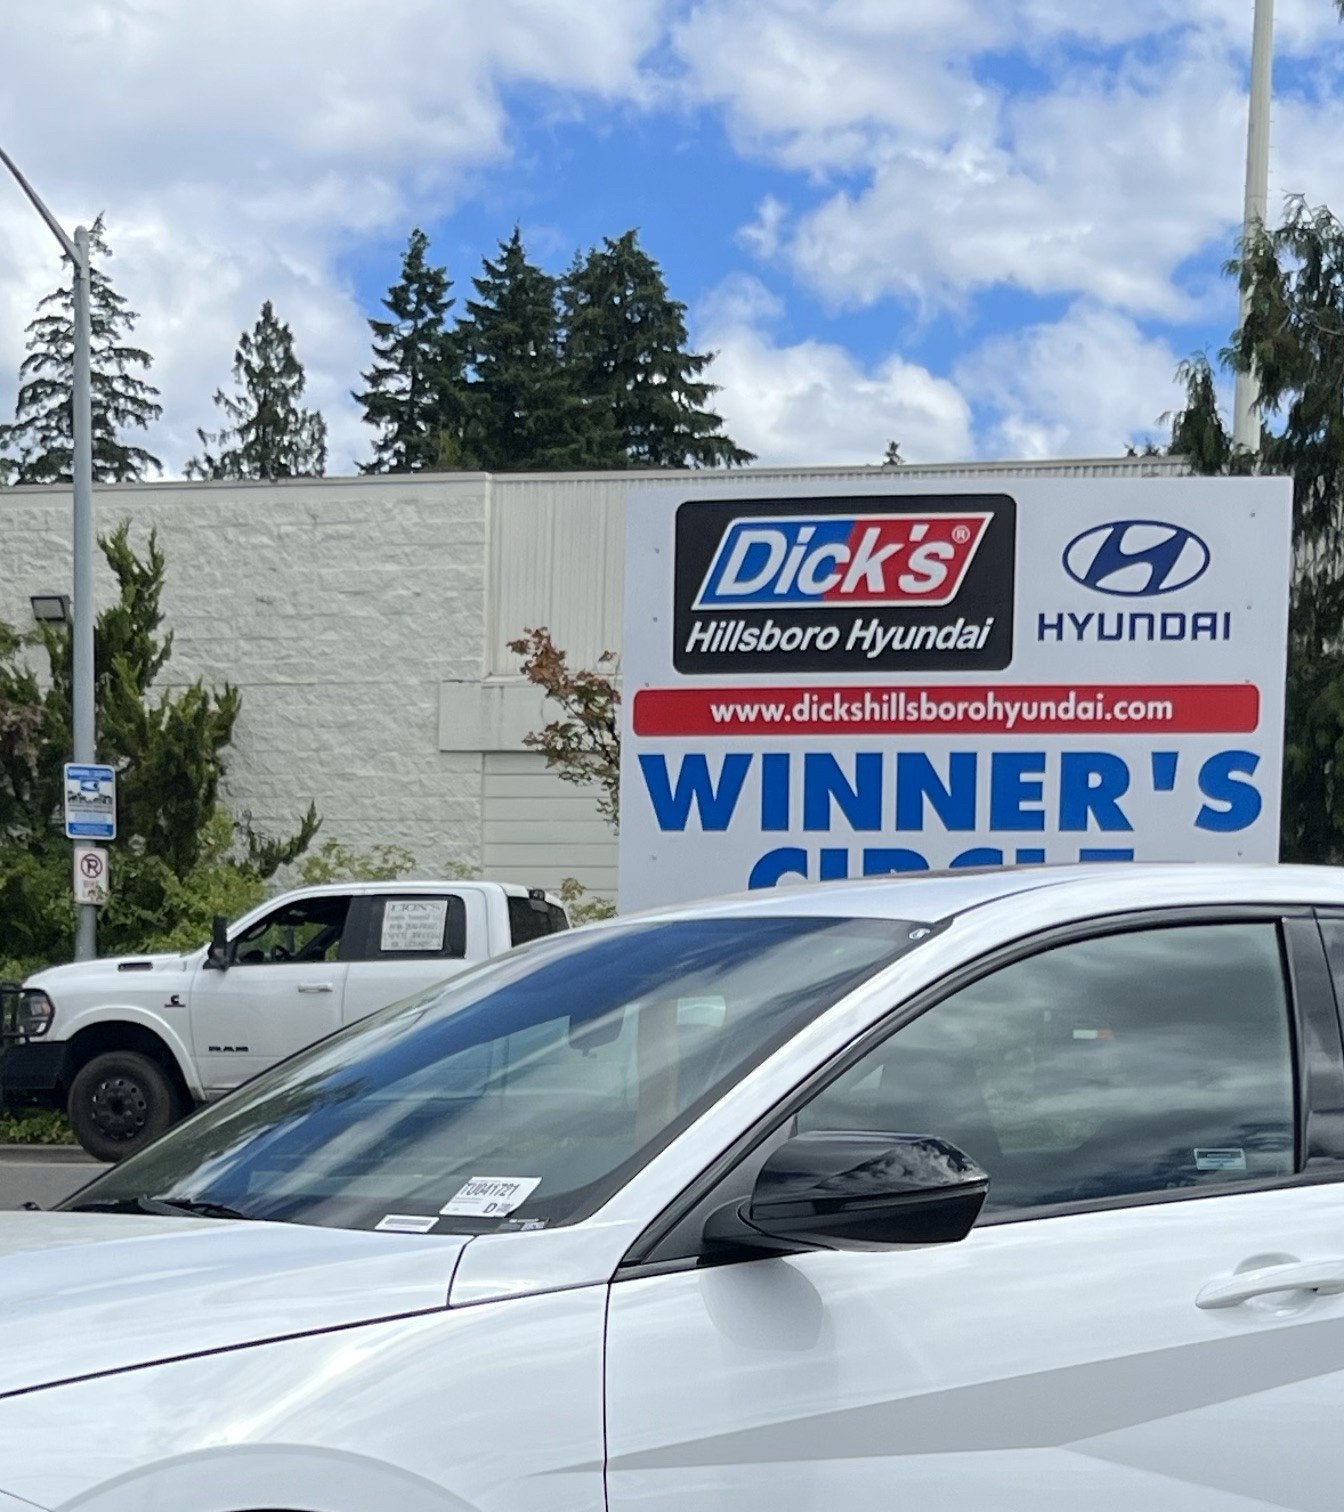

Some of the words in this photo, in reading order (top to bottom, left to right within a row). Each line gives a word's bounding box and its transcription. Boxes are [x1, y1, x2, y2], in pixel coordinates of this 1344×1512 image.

[714, 523, 956, 596] Dick's
[684, 619, 840, 654] Hillsboro
[845, 617, 994, 659] Hyundai
[1037, 611, 1232, 643] HYUNDAI
[709, 692, 1173, 729] www.dickshillsborohyundai.com
[638, 749, 1264, 833] WINNER'S
